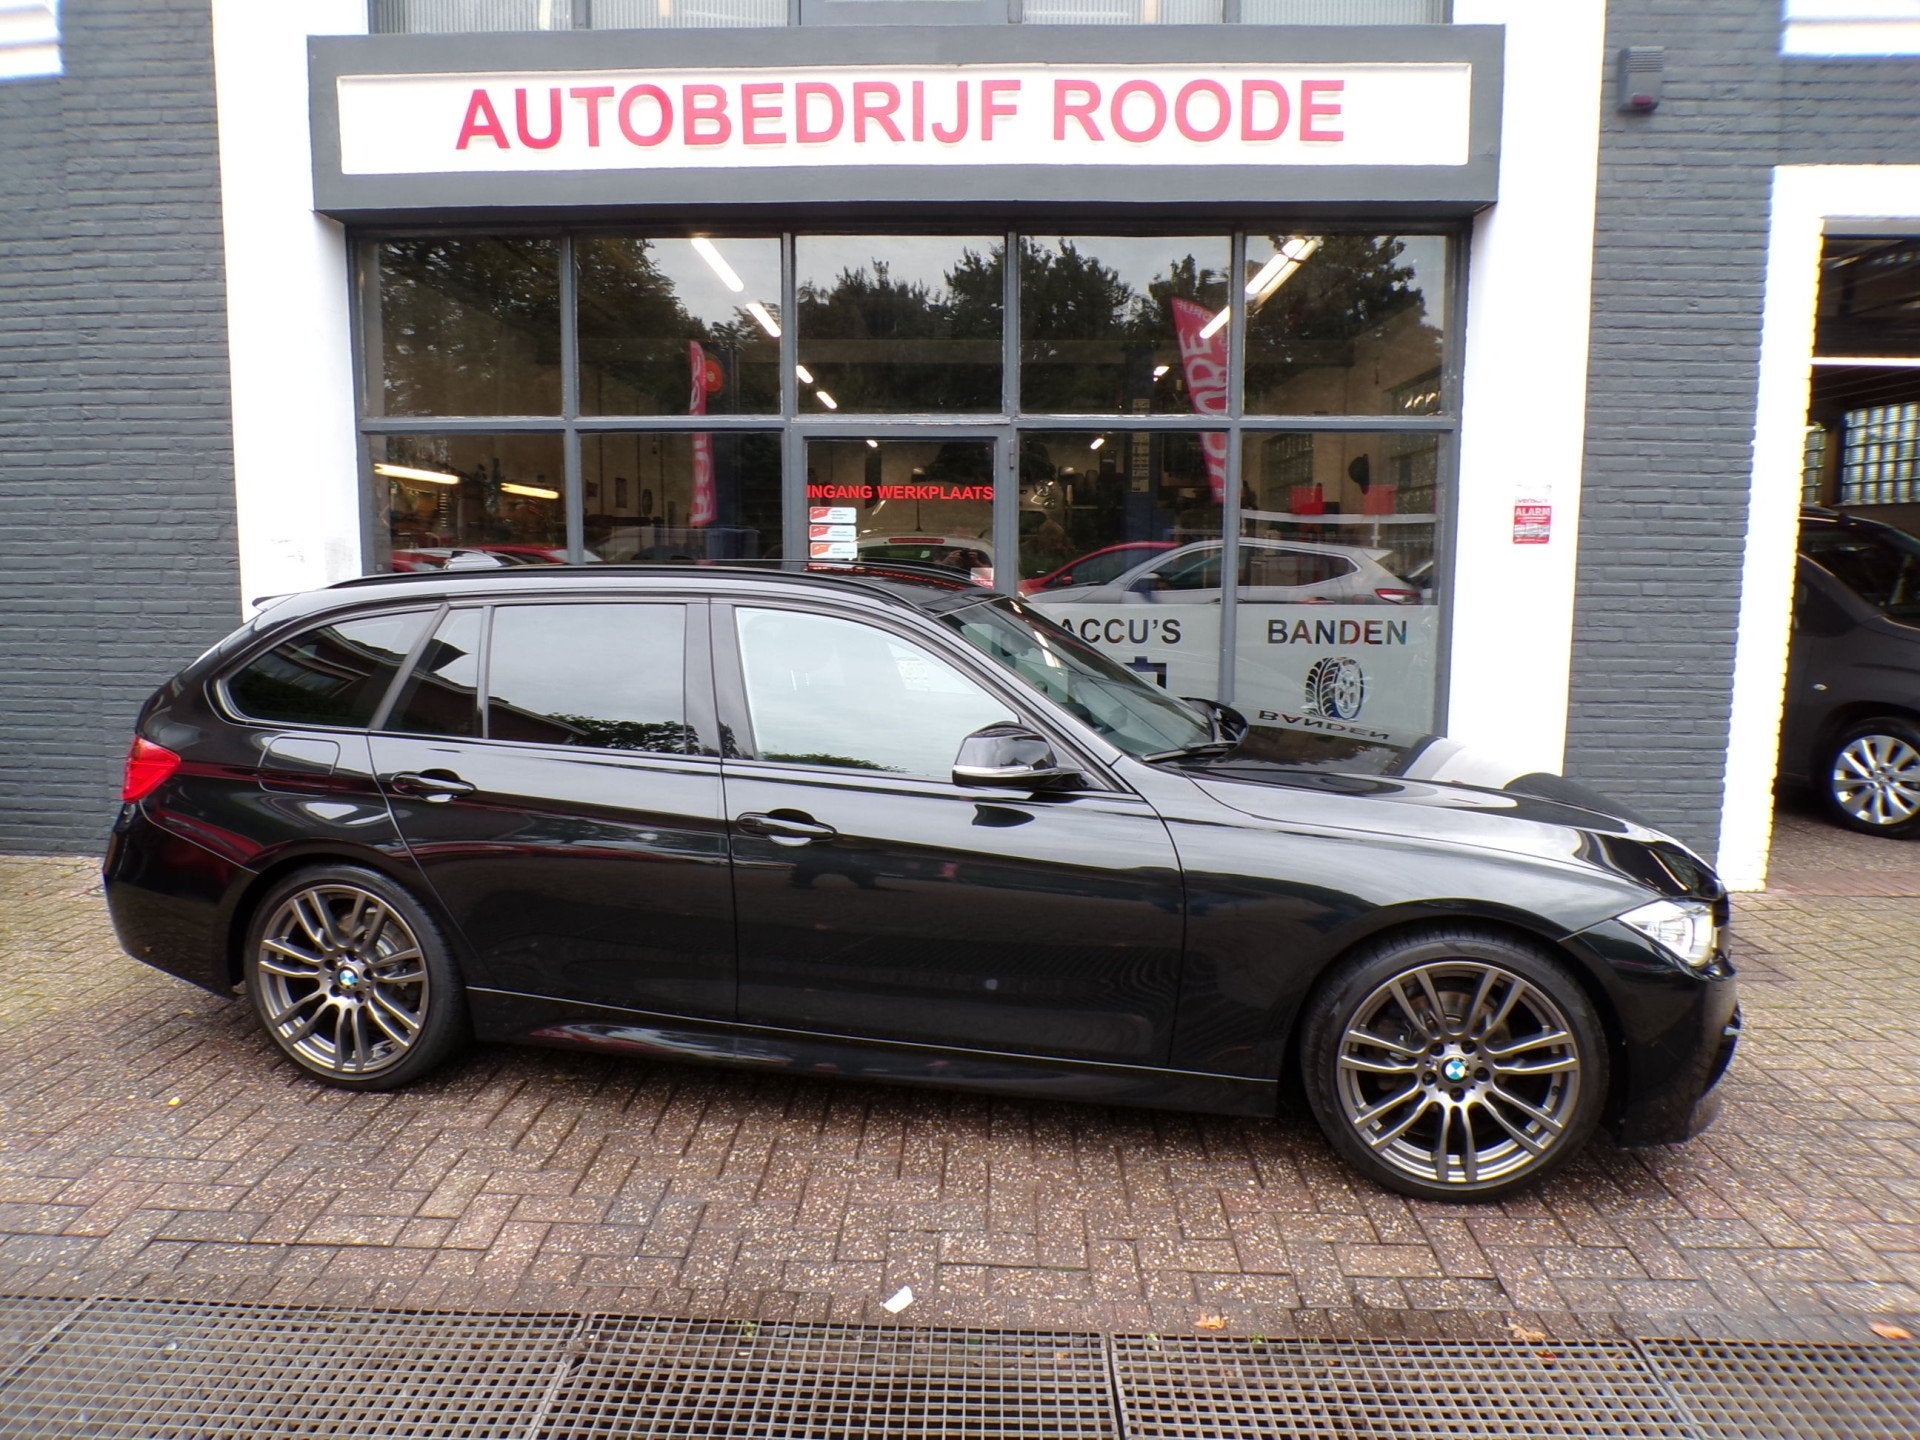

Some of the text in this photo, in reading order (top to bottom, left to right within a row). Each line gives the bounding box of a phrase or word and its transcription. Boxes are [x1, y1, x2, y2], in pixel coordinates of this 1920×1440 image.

[455, 79, 1345, 151] AUTOBEDRIJF ROODE
[807, 485, 994, 500] INGANG WERKPLAATS
[1267, 619, 1407, 645] BANDEN
